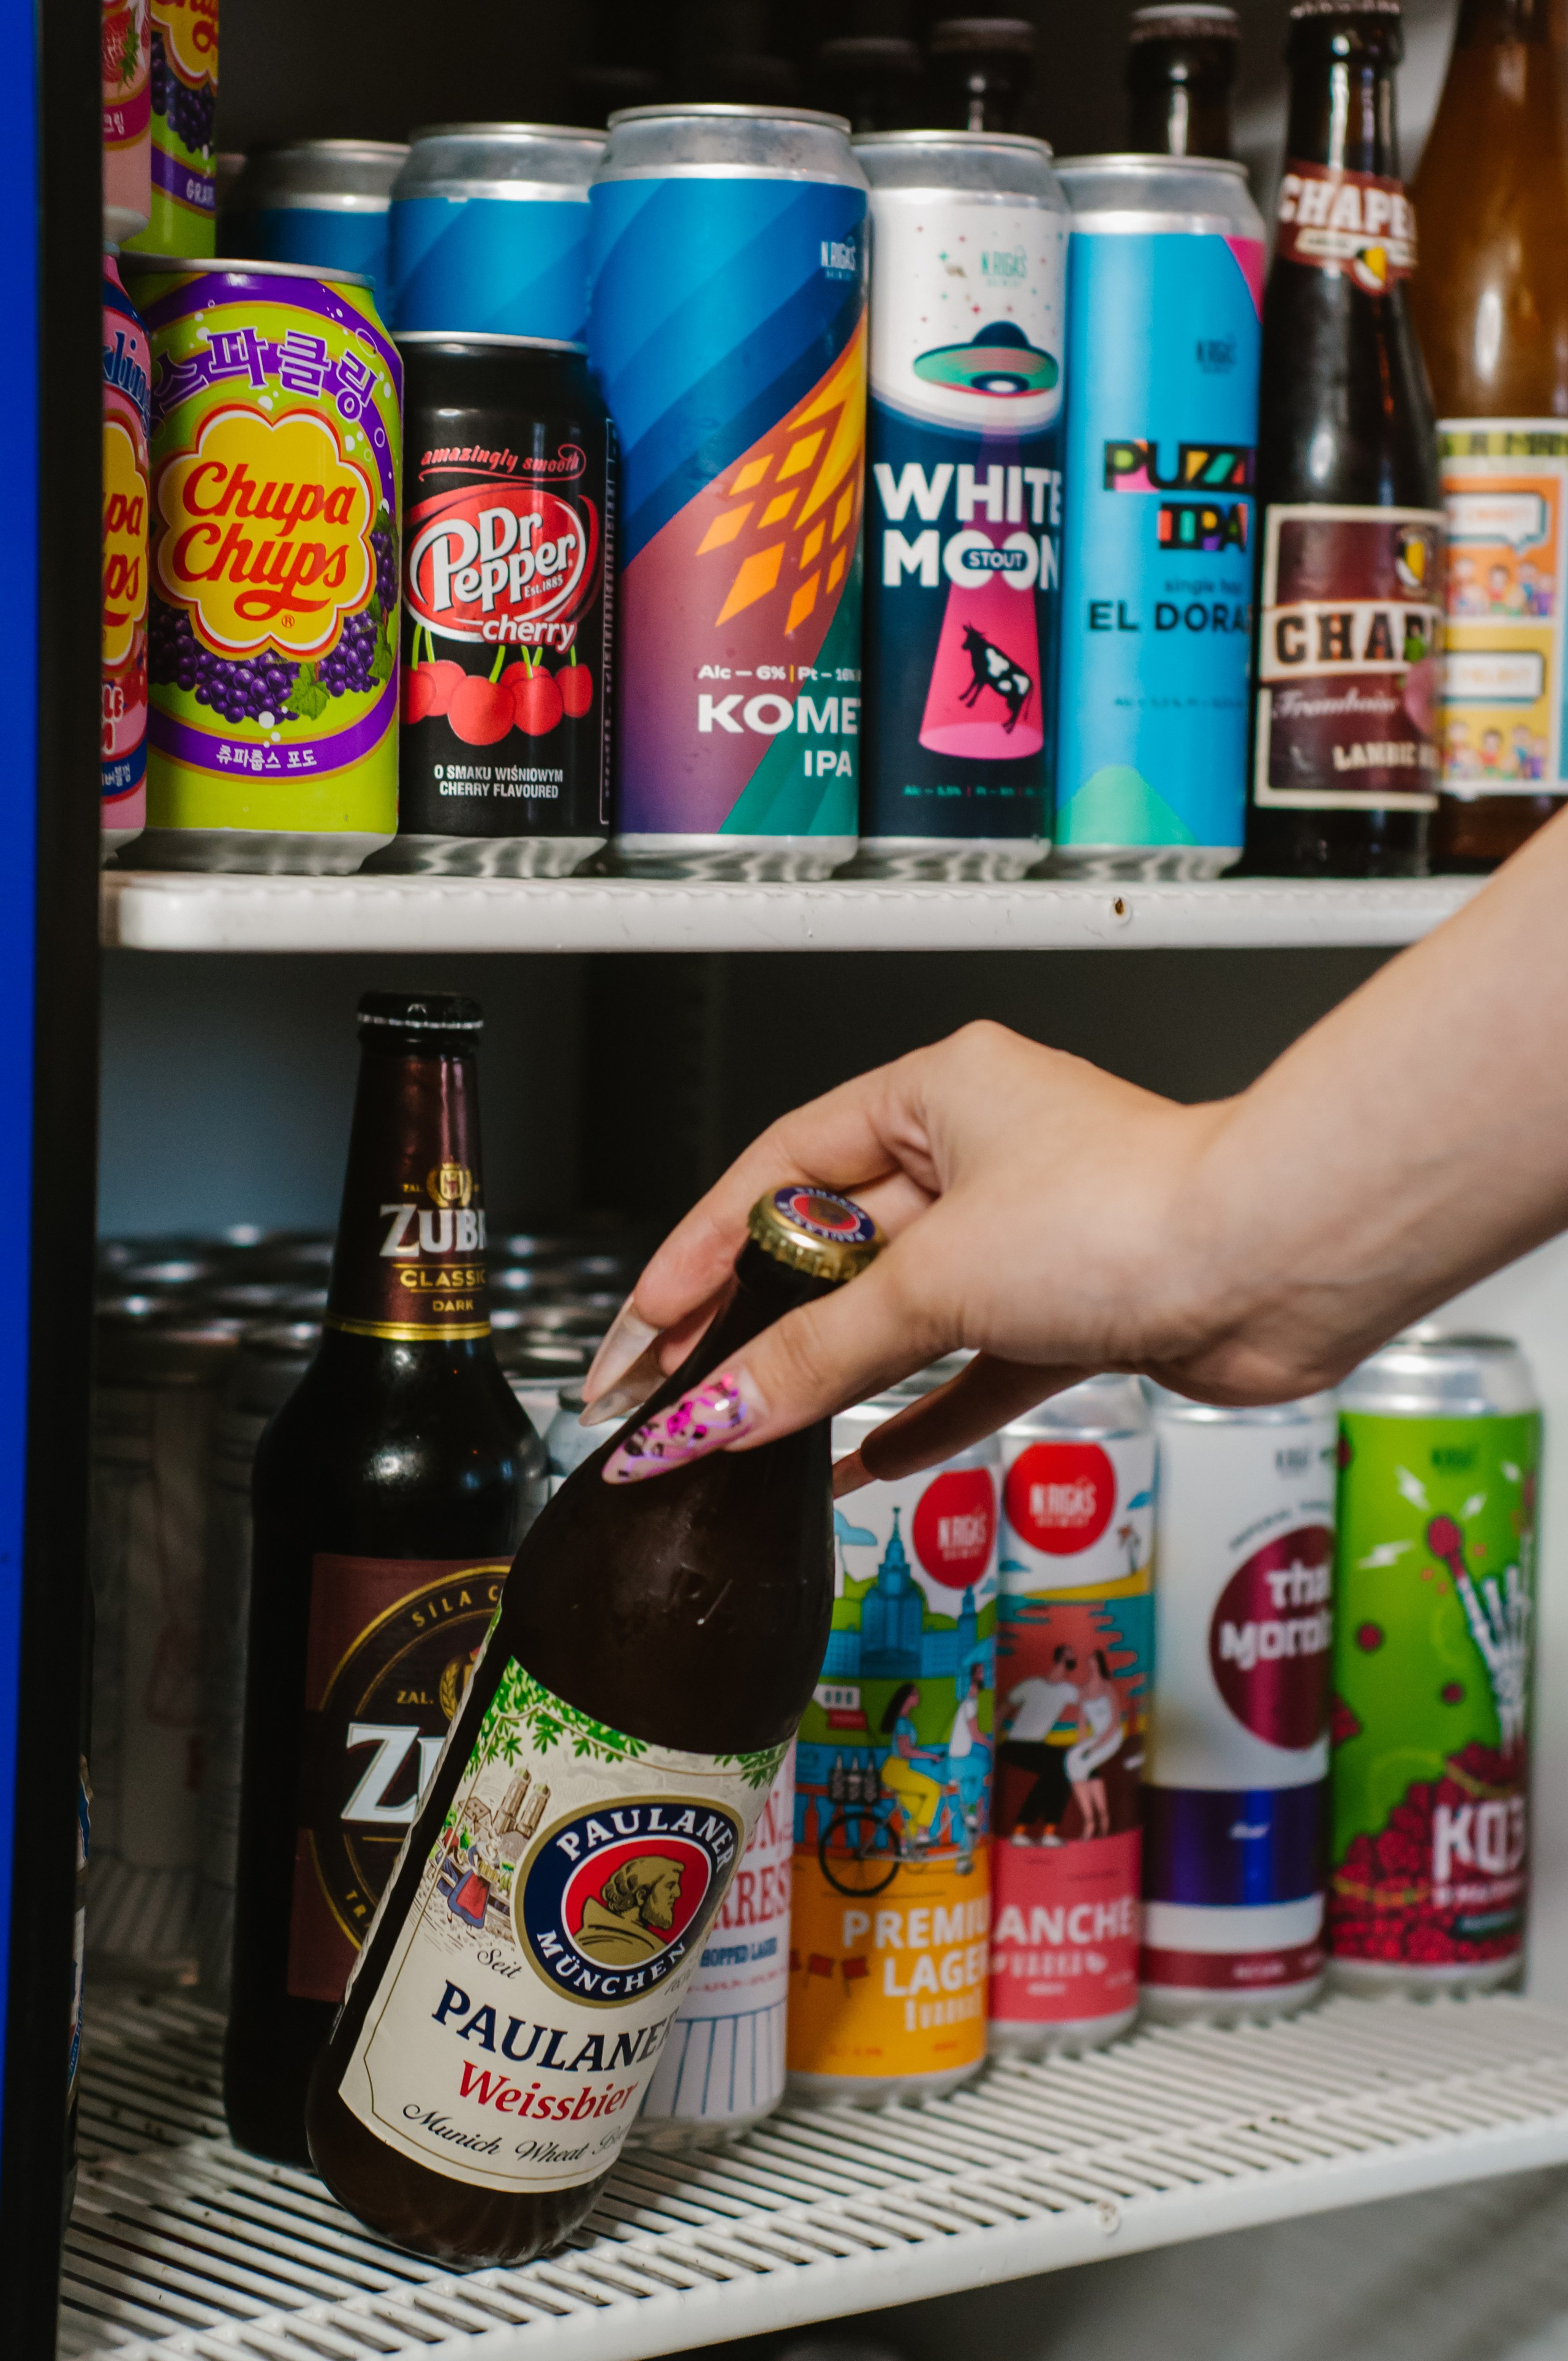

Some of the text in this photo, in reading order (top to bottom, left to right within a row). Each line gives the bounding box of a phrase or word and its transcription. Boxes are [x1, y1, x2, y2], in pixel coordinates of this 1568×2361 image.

[421, 445, 518, 474] amazingly
[182, 461, 357, 537] Chupa
[873, 463, 1062, 524] WHITE
[478, 507, 543, 562] Dr
[172, 522, 350, 622] Chups
[410, 518, 577, 613] Pepper
[968, 551, 1022, 568] STOUT
[483, 615, 576, 651] cherry
[1088, 600, 1247, 633] EL DORA
[698, 665, 732, 679] Alc
[756, 666, 786, 680] 6%
[797, 666, 818, 681] Pt
[287, 749, 317, 770] 포도
[434, 765, 564, 783] O SMAKU WIŚNIOWYM
[804, 750, 853, 777] IPA
[439, 780, 559, 799] CHERRY FLAVOURED
[432, 1299, 473, 1312] DARK
[556, 1808, 736, 1873] PAULANER
[477, 1948, 523, 1981] Seit
[537, 1930, 686, 1995] MÜNCHEN
[459, 2060, 639, 2121] Weissbier
[402, 2104, 590, 2164] Munich Wheat
